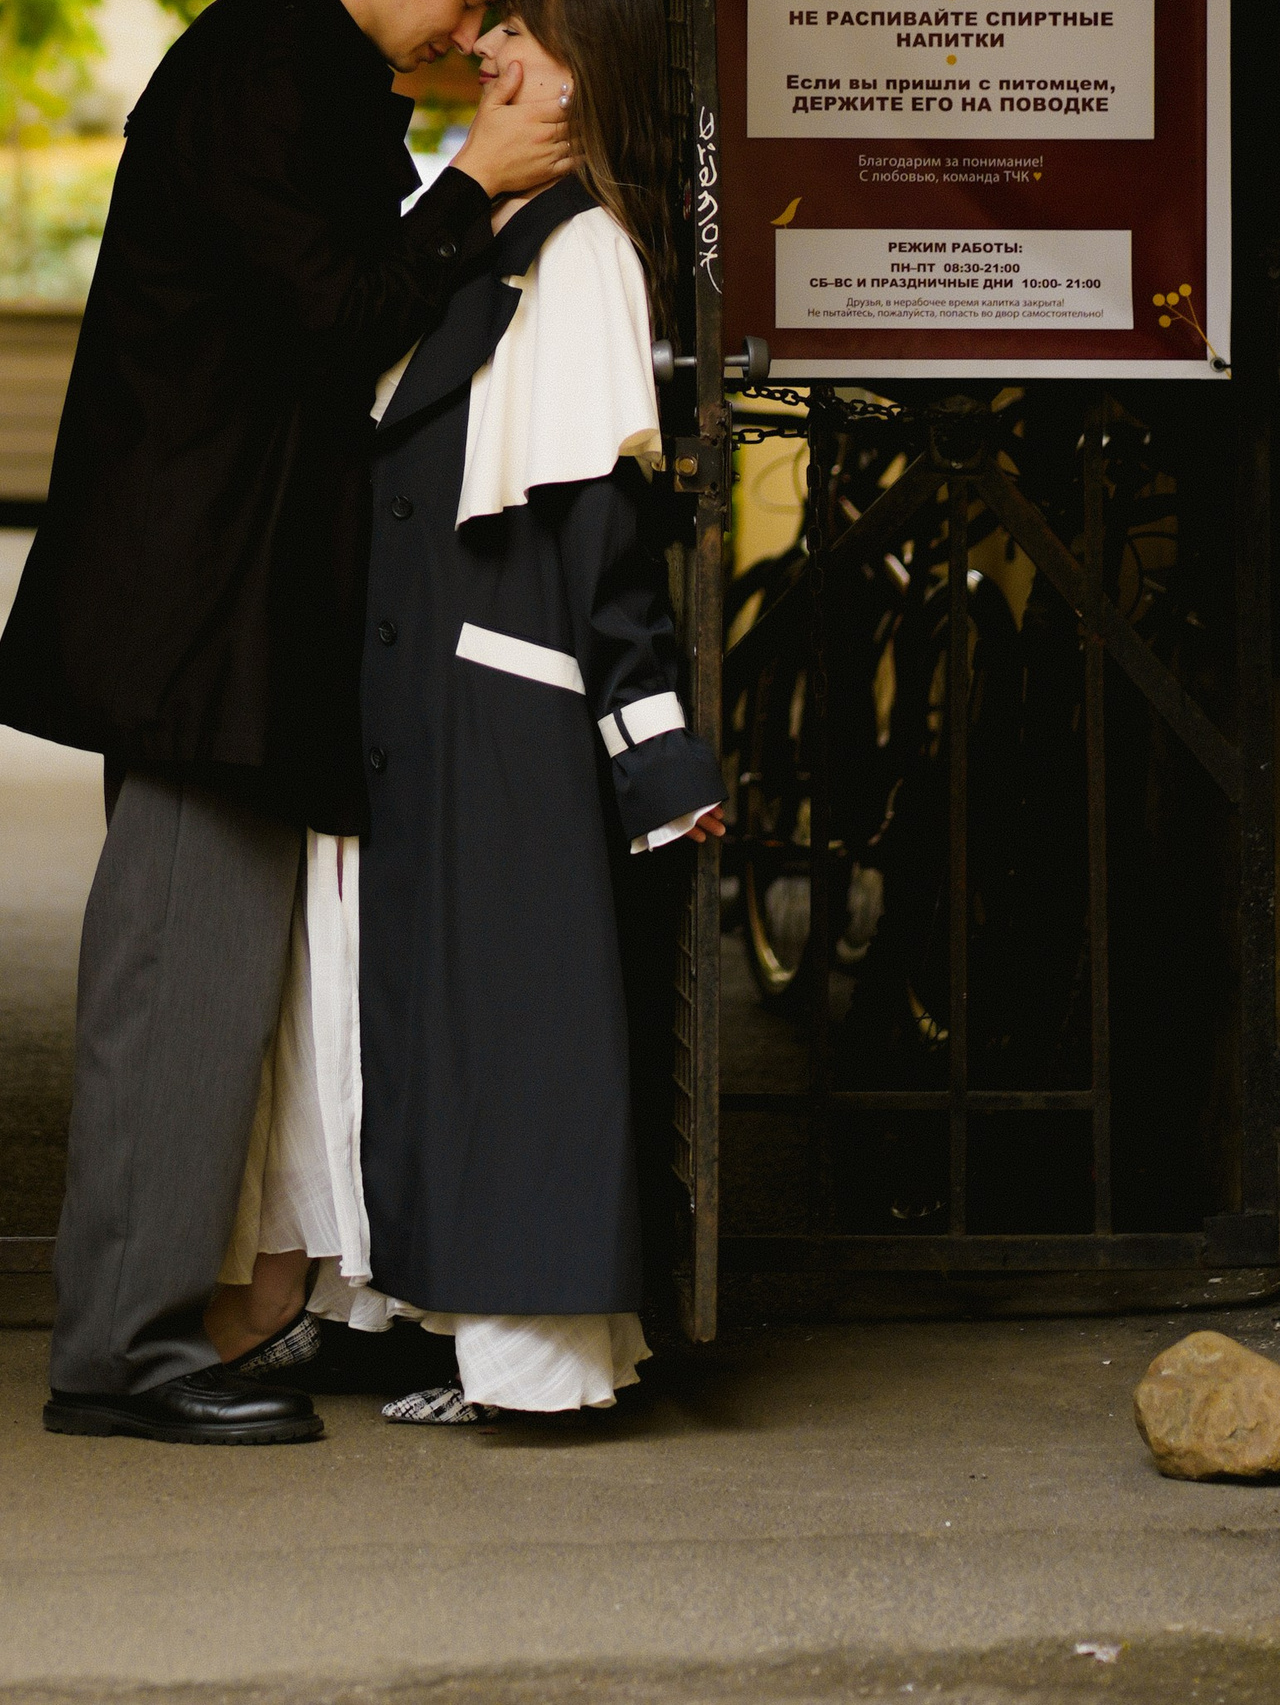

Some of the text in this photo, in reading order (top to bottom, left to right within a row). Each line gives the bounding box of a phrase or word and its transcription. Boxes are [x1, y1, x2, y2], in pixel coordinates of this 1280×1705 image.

[789, 9, 1113, 26] НЕ РАСПИВАЙТЕ СПИРТНЫЕ
[897, 33, 1004, 47] НАПИТКИ
[786, 74, 1115, 94] Если вы пришли с питомцем,
[792, 96, 1108, 115] ДЕРЖИТЕ ЕГО НА ПОВОДКЕ
[859, 154, 1043, 169] Благодарим за понимание!
[859, 170, 1029, 184] С любовью, команда ТЧК
[888, 242, 1022, 253] РЕЖИМ РАБОТЫ:
[943, 263, 1020, 273] 08:30-21:00
[857, 278, 866, 288] И
[871, 278, 978, 289] ПРАЗДНИЧНЫЕ
[983, 279, 1013, 289] ДНИ
[1066, 279, 1101, 289] 21:00
[846, 297, 883, 308] Друзья,
[893, 297, 946, 307] нерабочее
[948, 300, 979, 308] время
[981, 299, 1021, 307] калитка
[1024, 299, 1064, 308] закрыта!
[807, 308, 821, 317] Не
[823, 308, 875, 318] пытайтесь,
[877, 308, 937, 319] пожалуйста,
[939, 310, 979, 318] попасть
[995, 311, 1020, 319] двор
[1022, 310, 1104, 318] самостоятельно!
